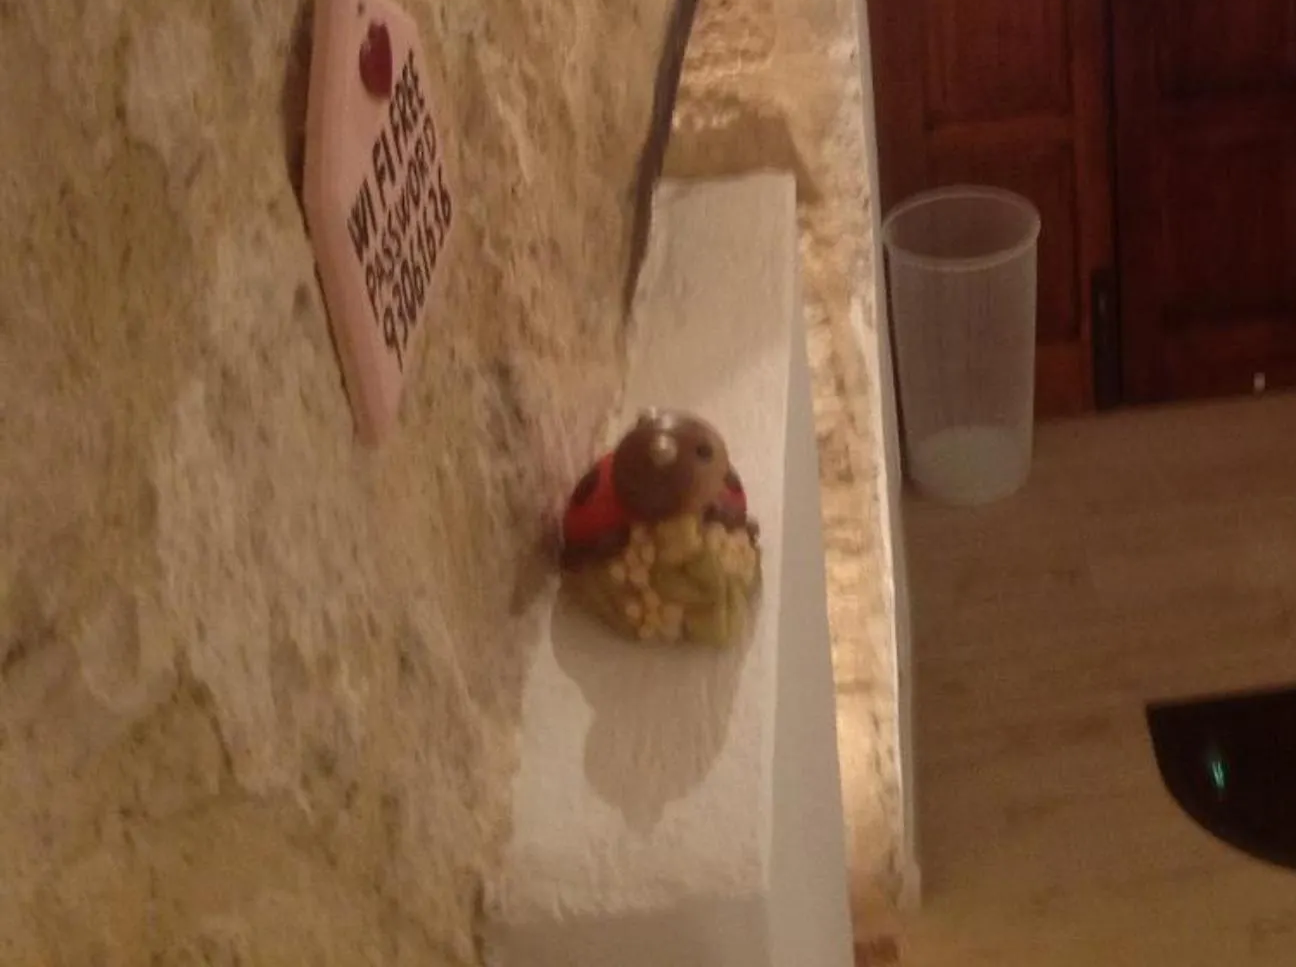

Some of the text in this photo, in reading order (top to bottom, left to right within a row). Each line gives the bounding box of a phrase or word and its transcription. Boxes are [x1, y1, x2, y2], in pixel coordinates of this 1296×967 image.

[347, 48, 424, 266] WI FI FREE
[366, 114, 437, 327] PASSWORD
